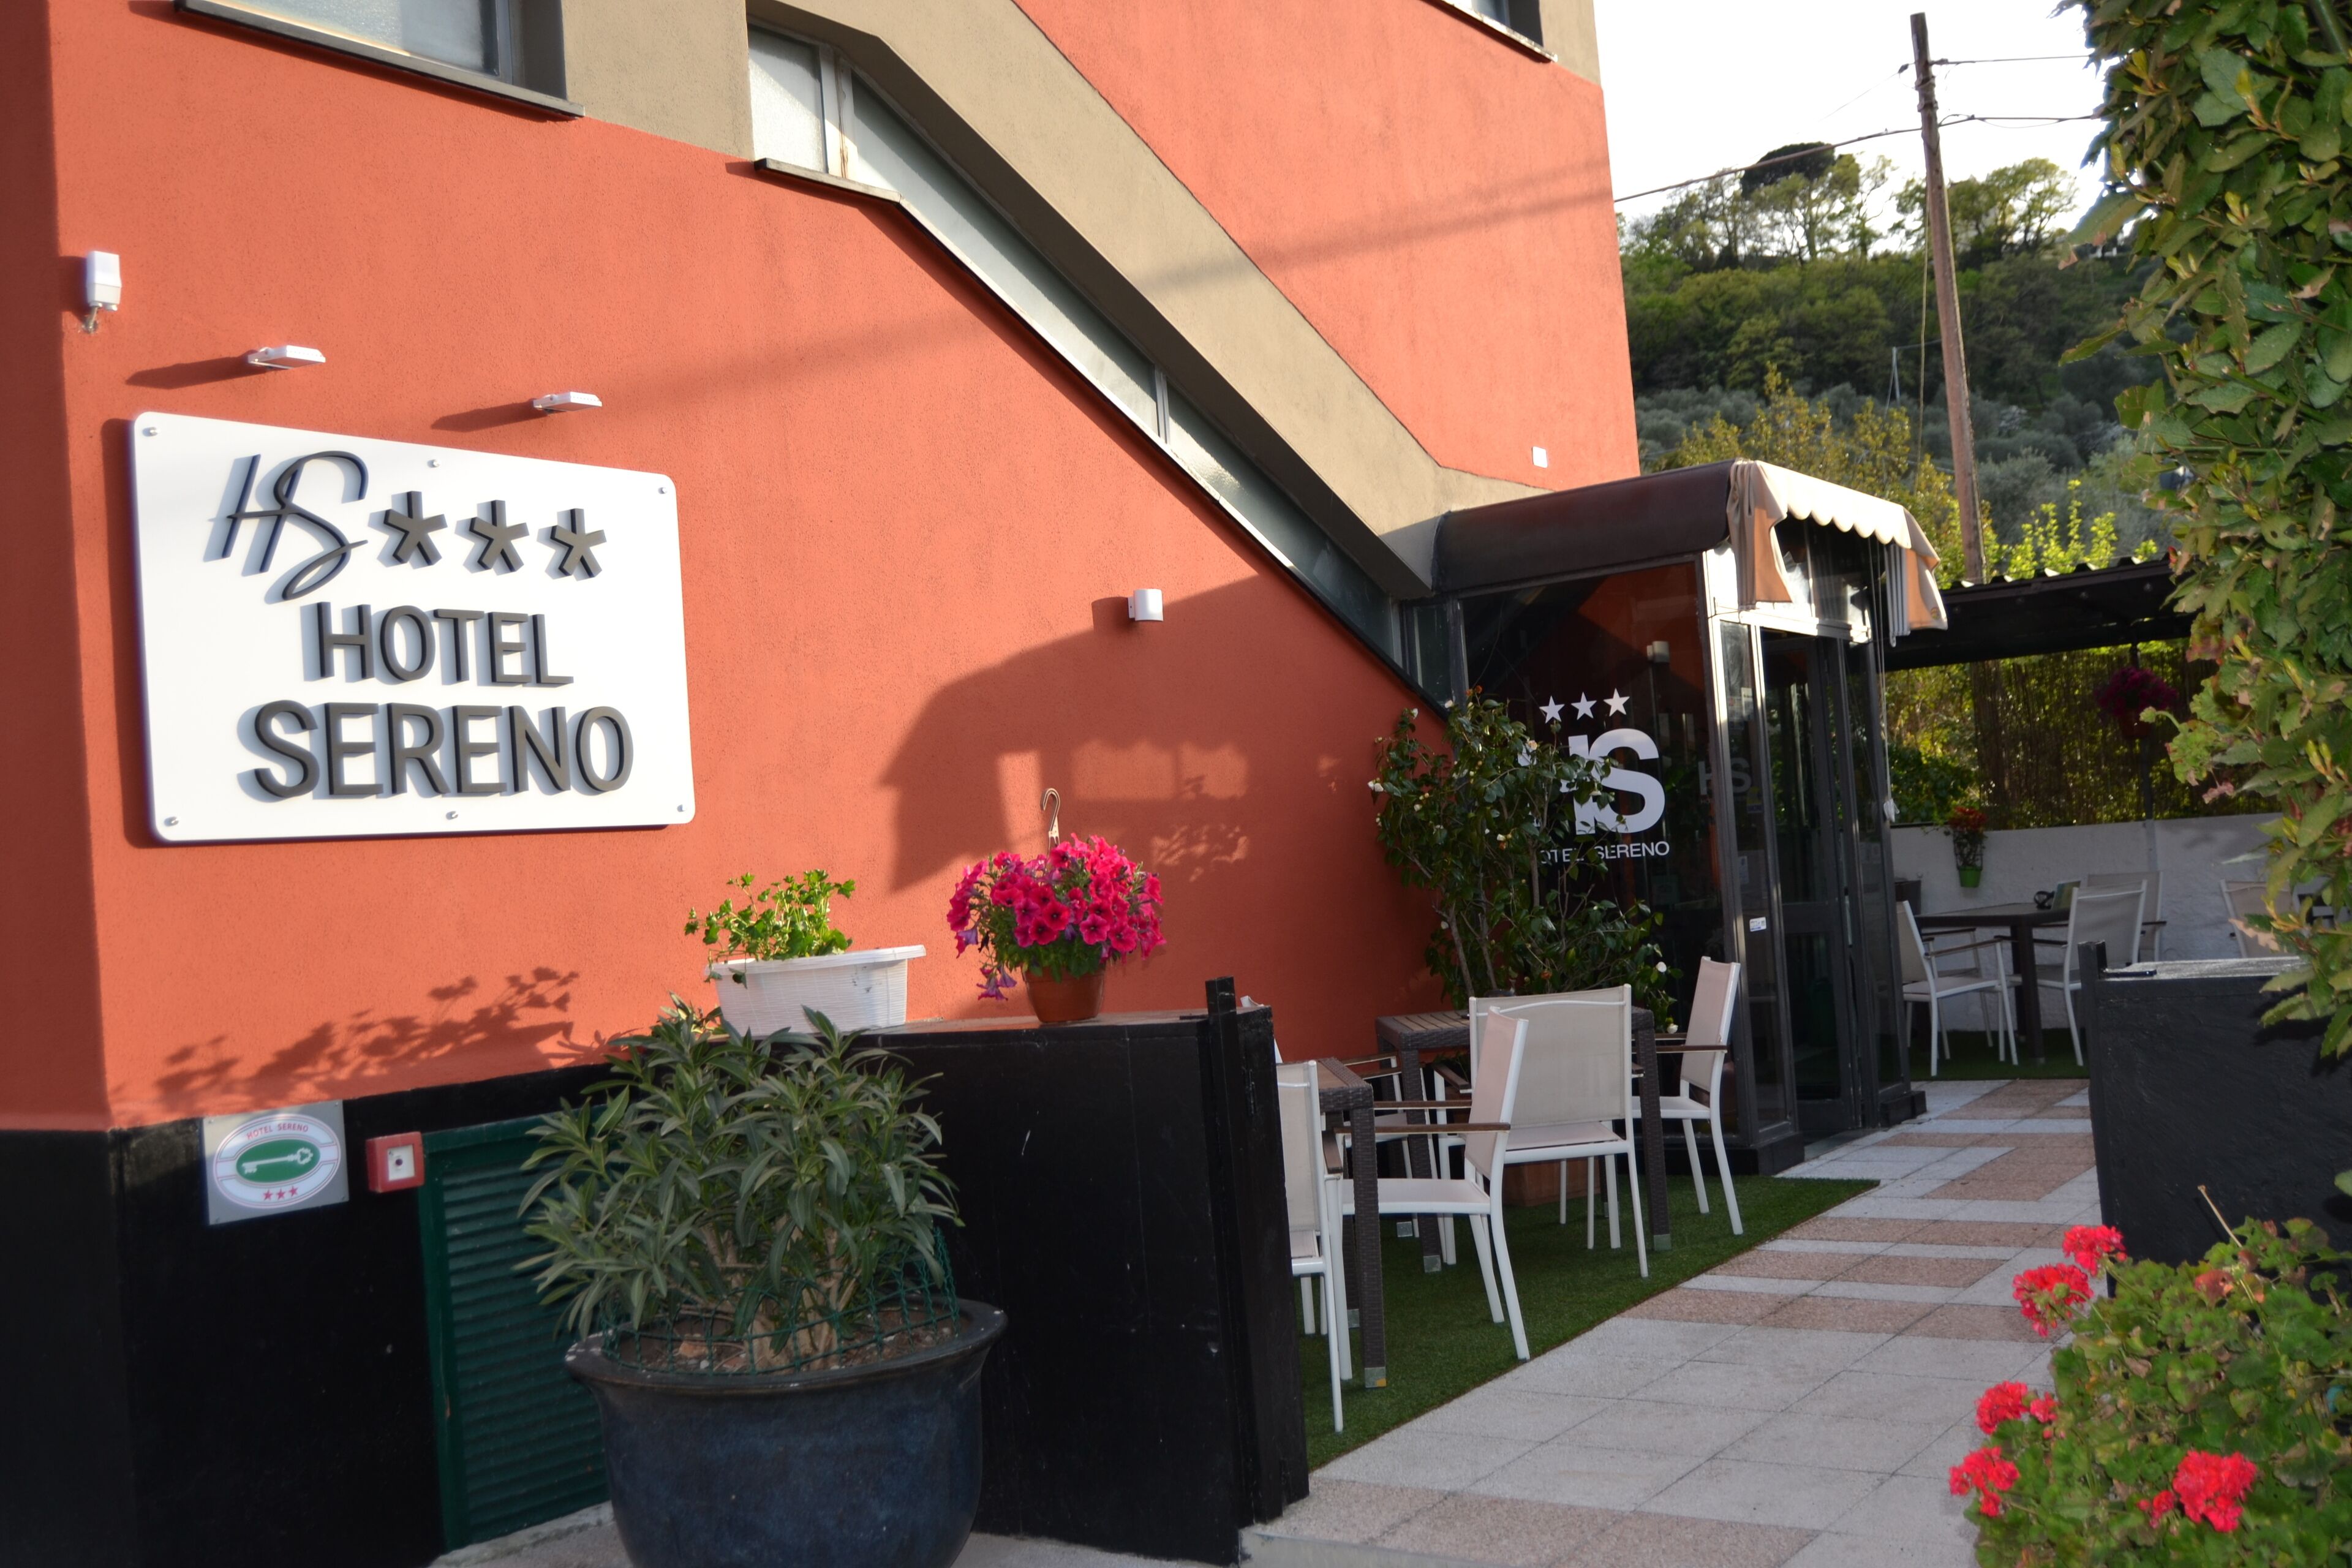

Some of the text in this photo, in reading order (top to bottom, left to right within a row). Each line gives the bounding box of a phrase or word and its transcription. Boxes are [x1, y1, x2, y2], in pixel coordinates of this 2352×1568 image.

[316, 601, 575, 685] HOTEL
[254, 699, 635, 798] SERENO
[1539, 840, 1670, 864] OTE SERENO
[246, 1123, 309, 1140] HOTEL SERENO
